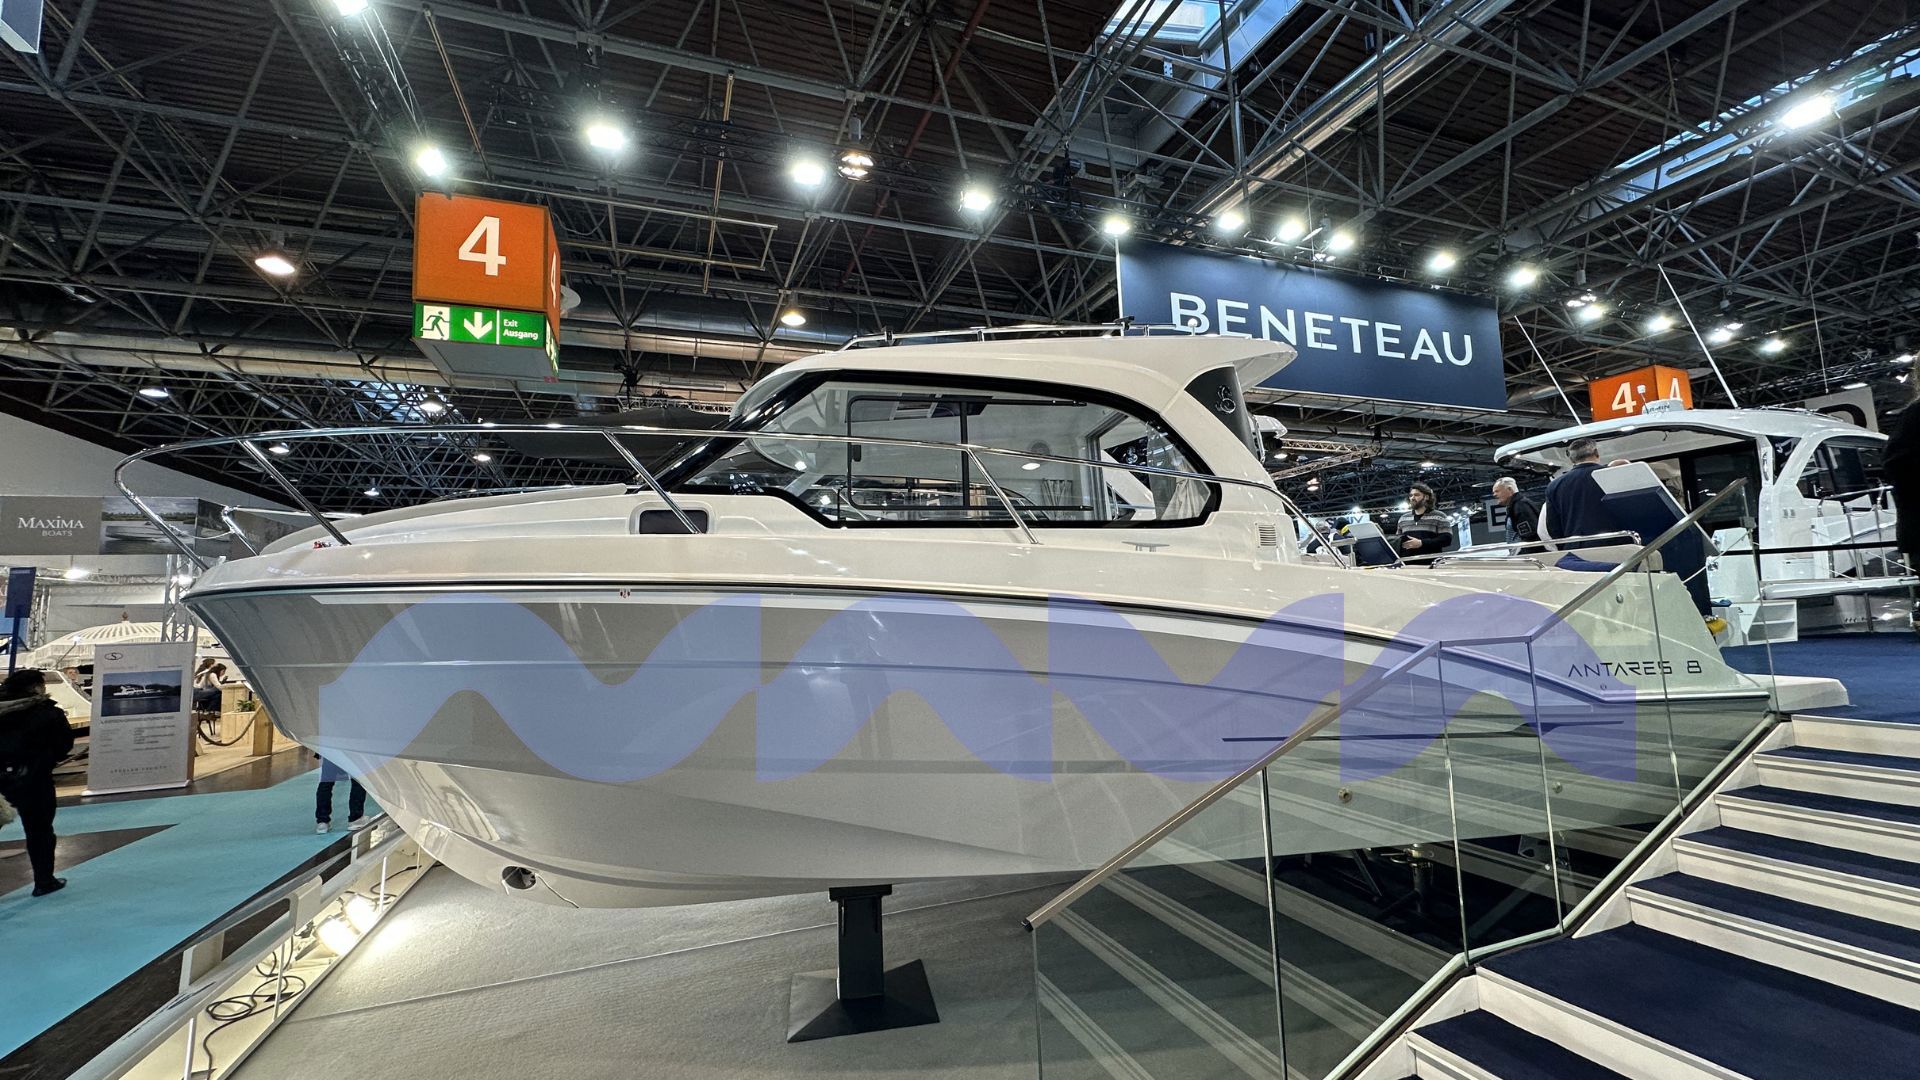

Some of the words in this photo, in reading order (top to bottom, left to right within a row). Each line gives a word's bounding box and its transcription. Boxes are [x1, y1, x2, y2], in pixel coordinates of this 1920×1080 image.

[458, 215, 507, 276] 4
[550, 252, 557, 309] 4
[503, 319, 518, 327] Exit
[503, 329, 539, 340] Ausgang
[1169, 292, 1473, 366] BENETEAU
[1611, 382, 1636, 413] 4
[1568, 661, 1672, 678] ANTARES
[1687, 660, 1702, 673] 8
